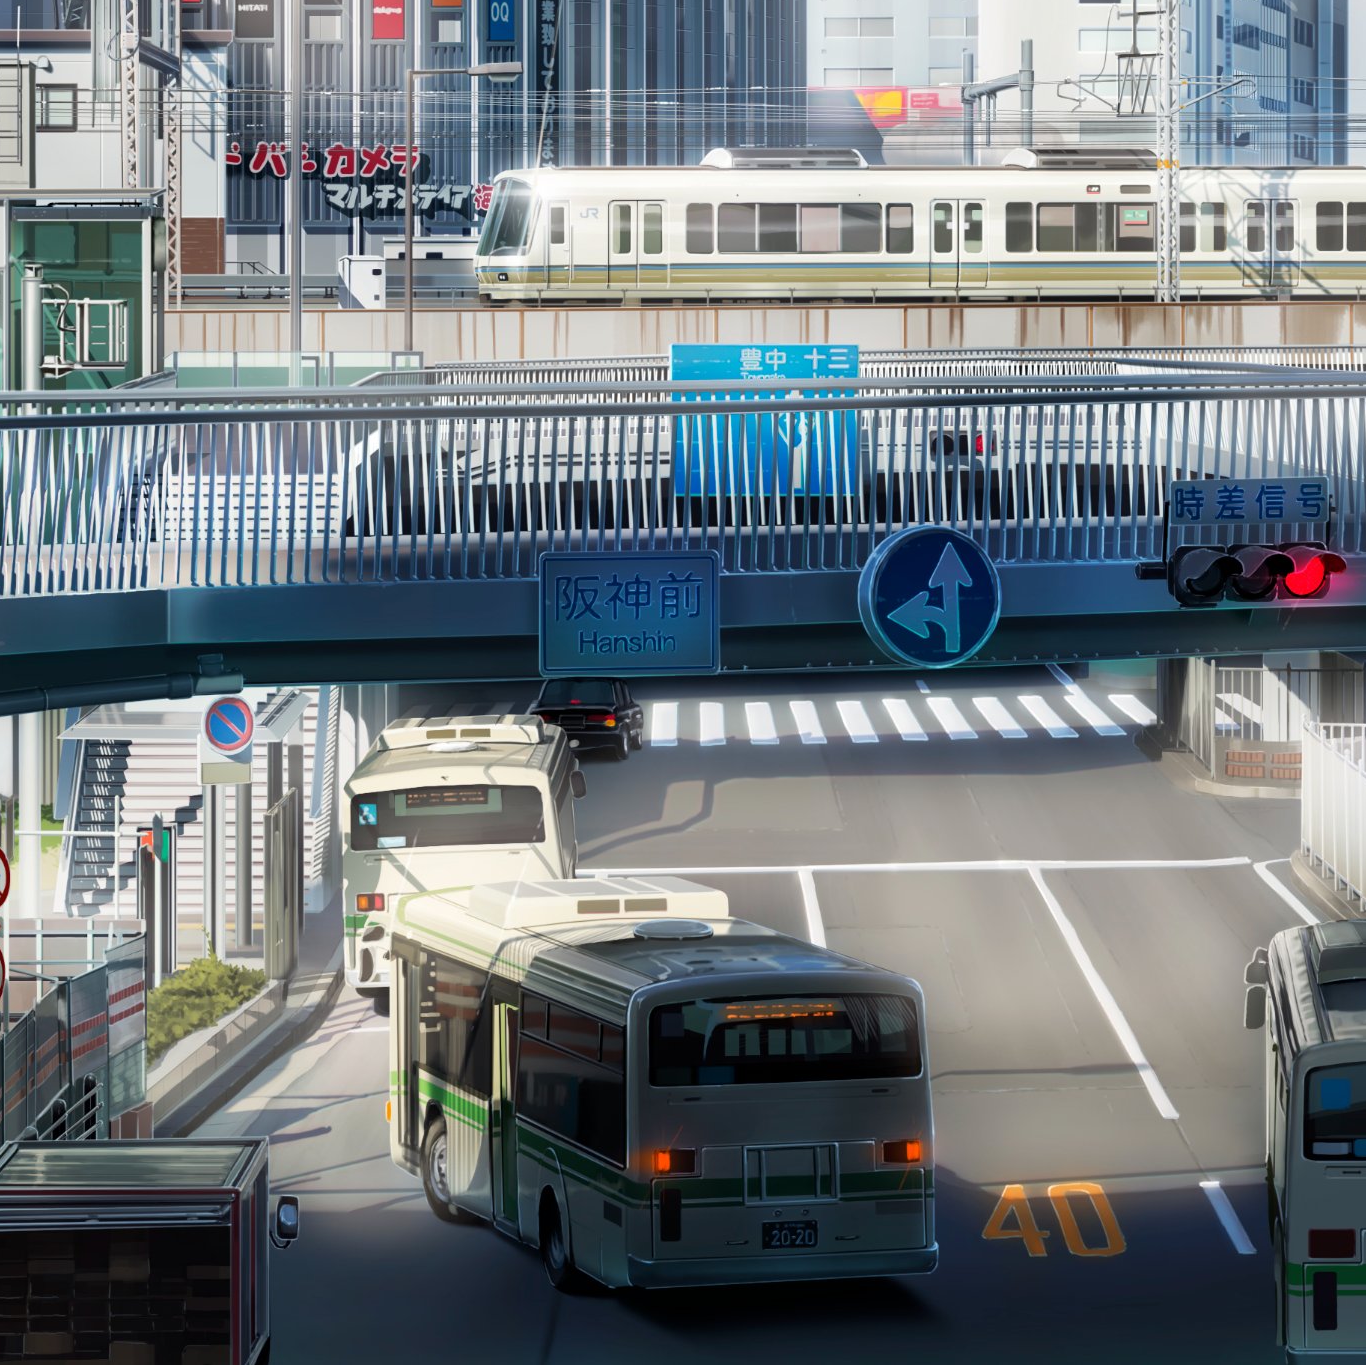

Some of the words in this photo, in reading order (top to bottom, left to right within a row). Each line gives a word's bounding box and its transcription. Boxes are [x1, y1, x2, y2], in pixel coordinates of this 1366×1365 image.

[579, 207, 599, 219] JR
[739, 347, 787, 372] 豊中
[803, 347, 850, 371] 十三
[1174, 483, 1326, 520] 時差信号
[554, 571, 704, 621] 阪神前
[578, 630, 677, 654] Hanshin
[982, 1183, 1127, 1258] 40
